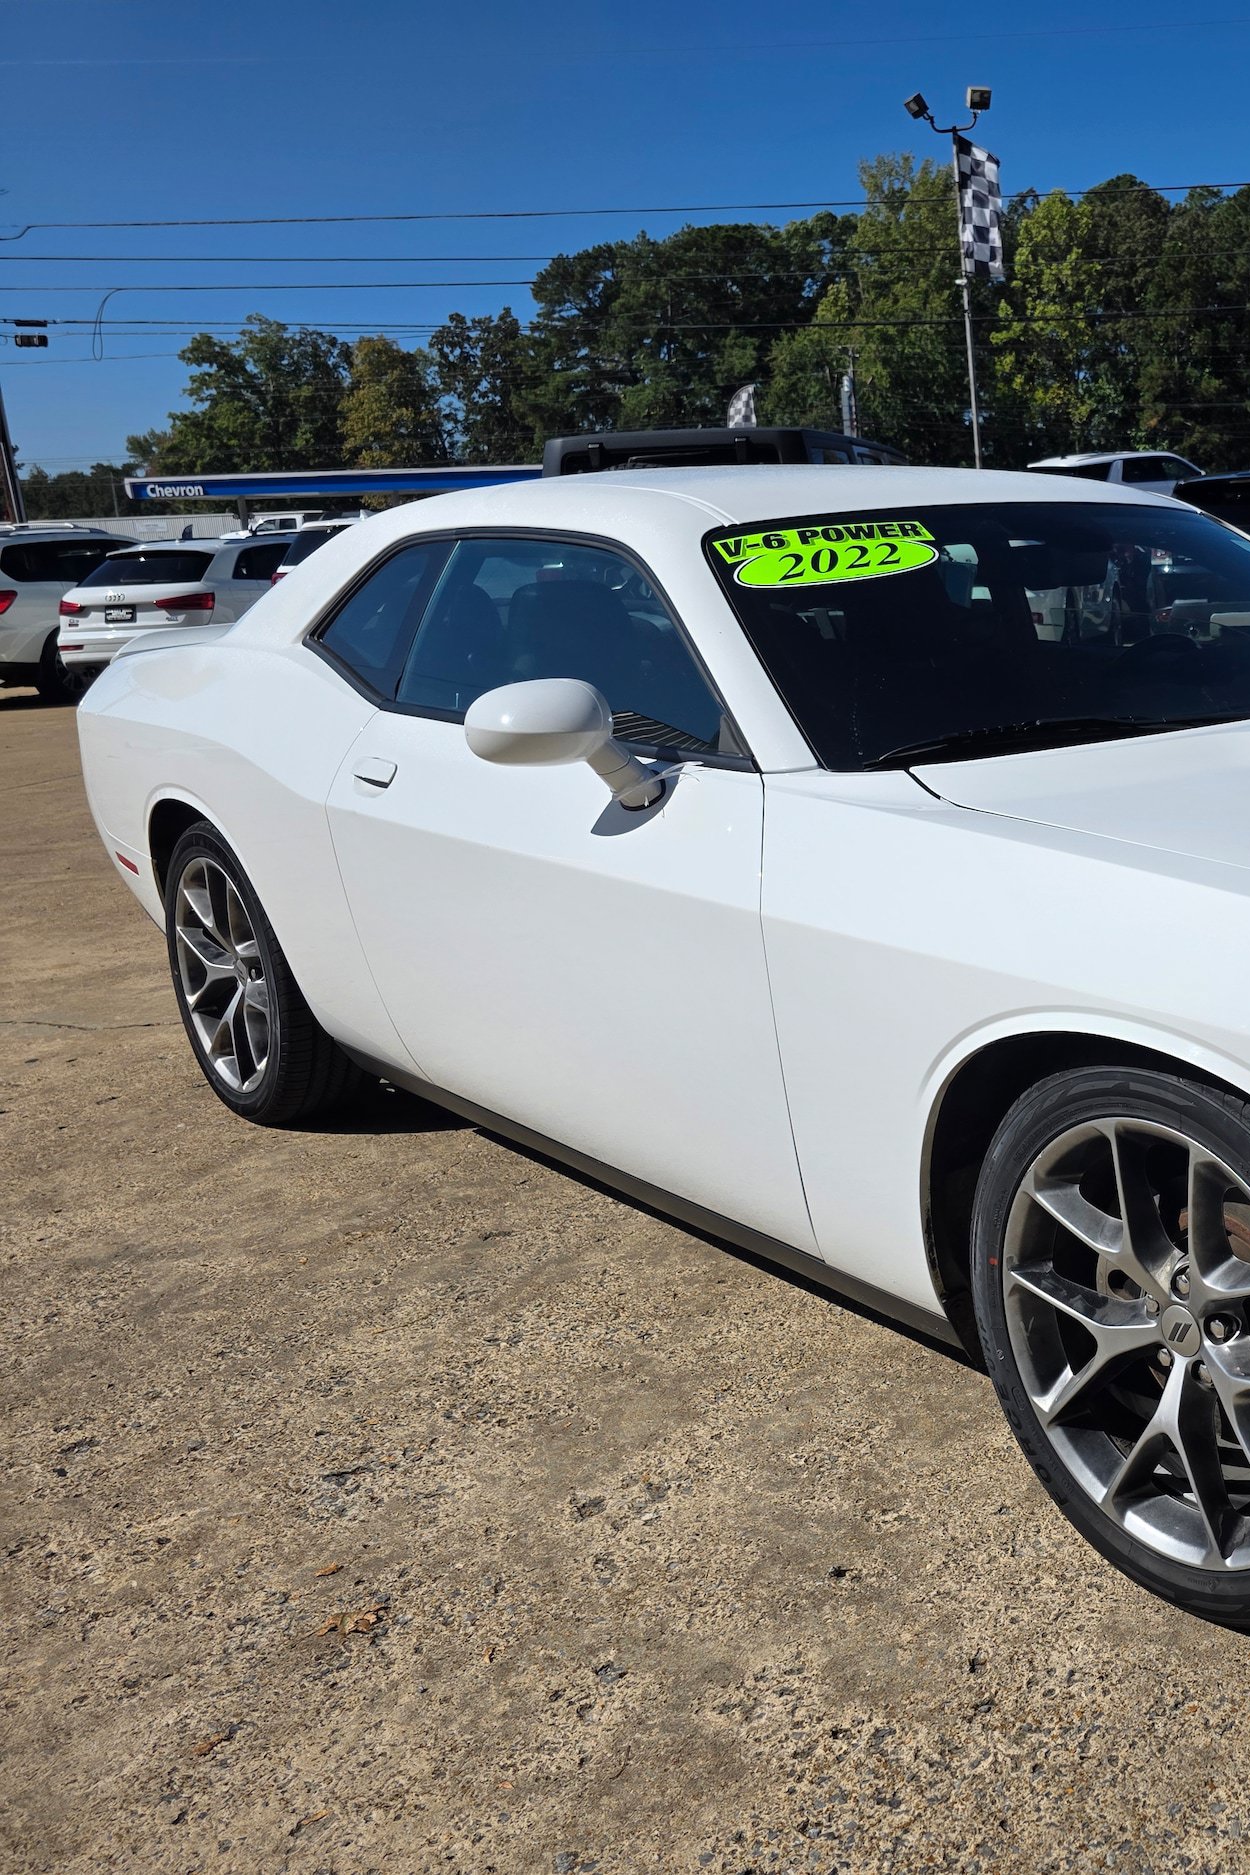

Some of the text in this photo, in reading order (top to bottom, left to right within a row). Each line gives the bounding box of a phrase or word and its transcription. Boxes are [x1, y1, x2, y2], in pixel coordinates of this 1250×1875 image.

[146, 484, 204, 498] Chevron
[719, 521, 925, 558] V-6 POWER
[778, 542, 902, 582] 2022
